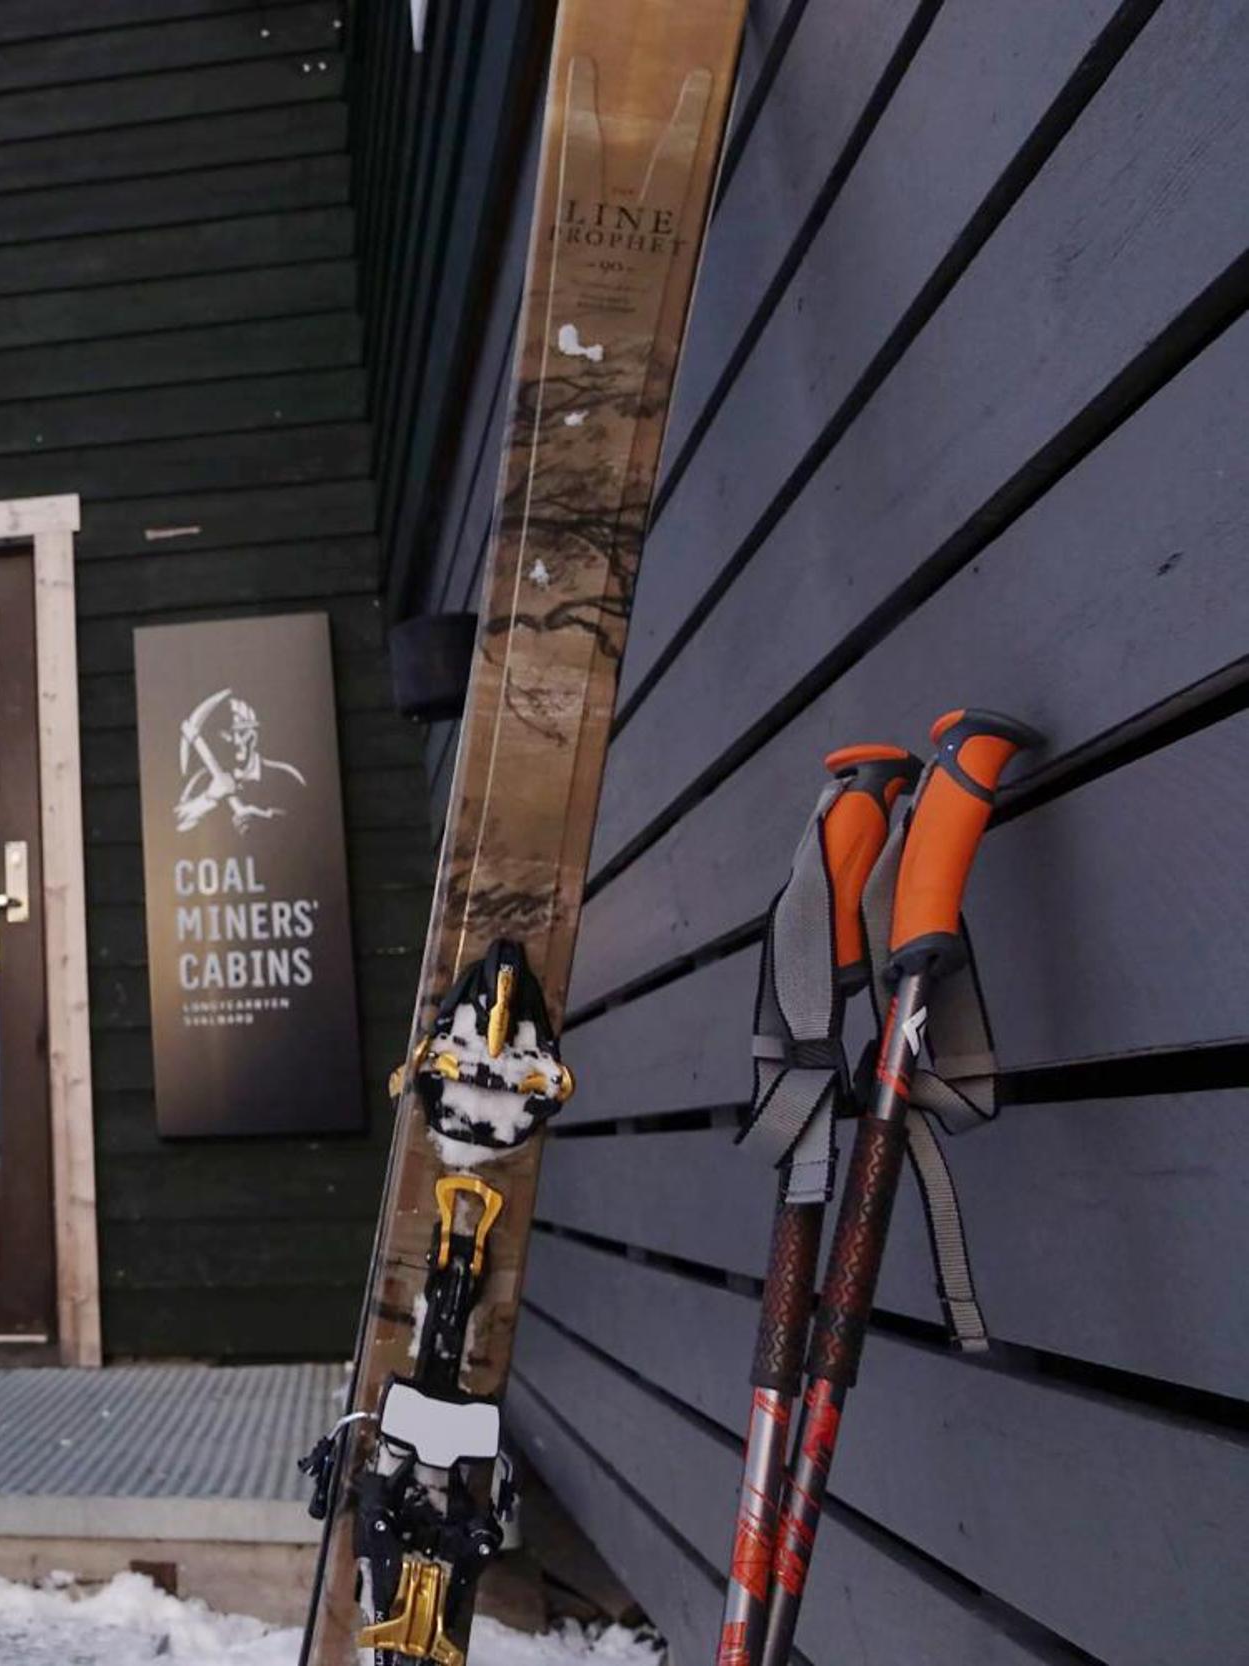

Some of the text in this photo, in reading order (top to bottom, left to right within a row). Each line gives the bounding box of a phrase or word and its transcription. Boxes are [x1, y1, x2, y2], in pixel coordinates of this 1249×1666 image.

[563, 200, 674, 235] LINE
[175, 857, 266, 896] COAL
[177, 900, 319, 941] MINERS'
[179, 947, 313, 990] CABINS
